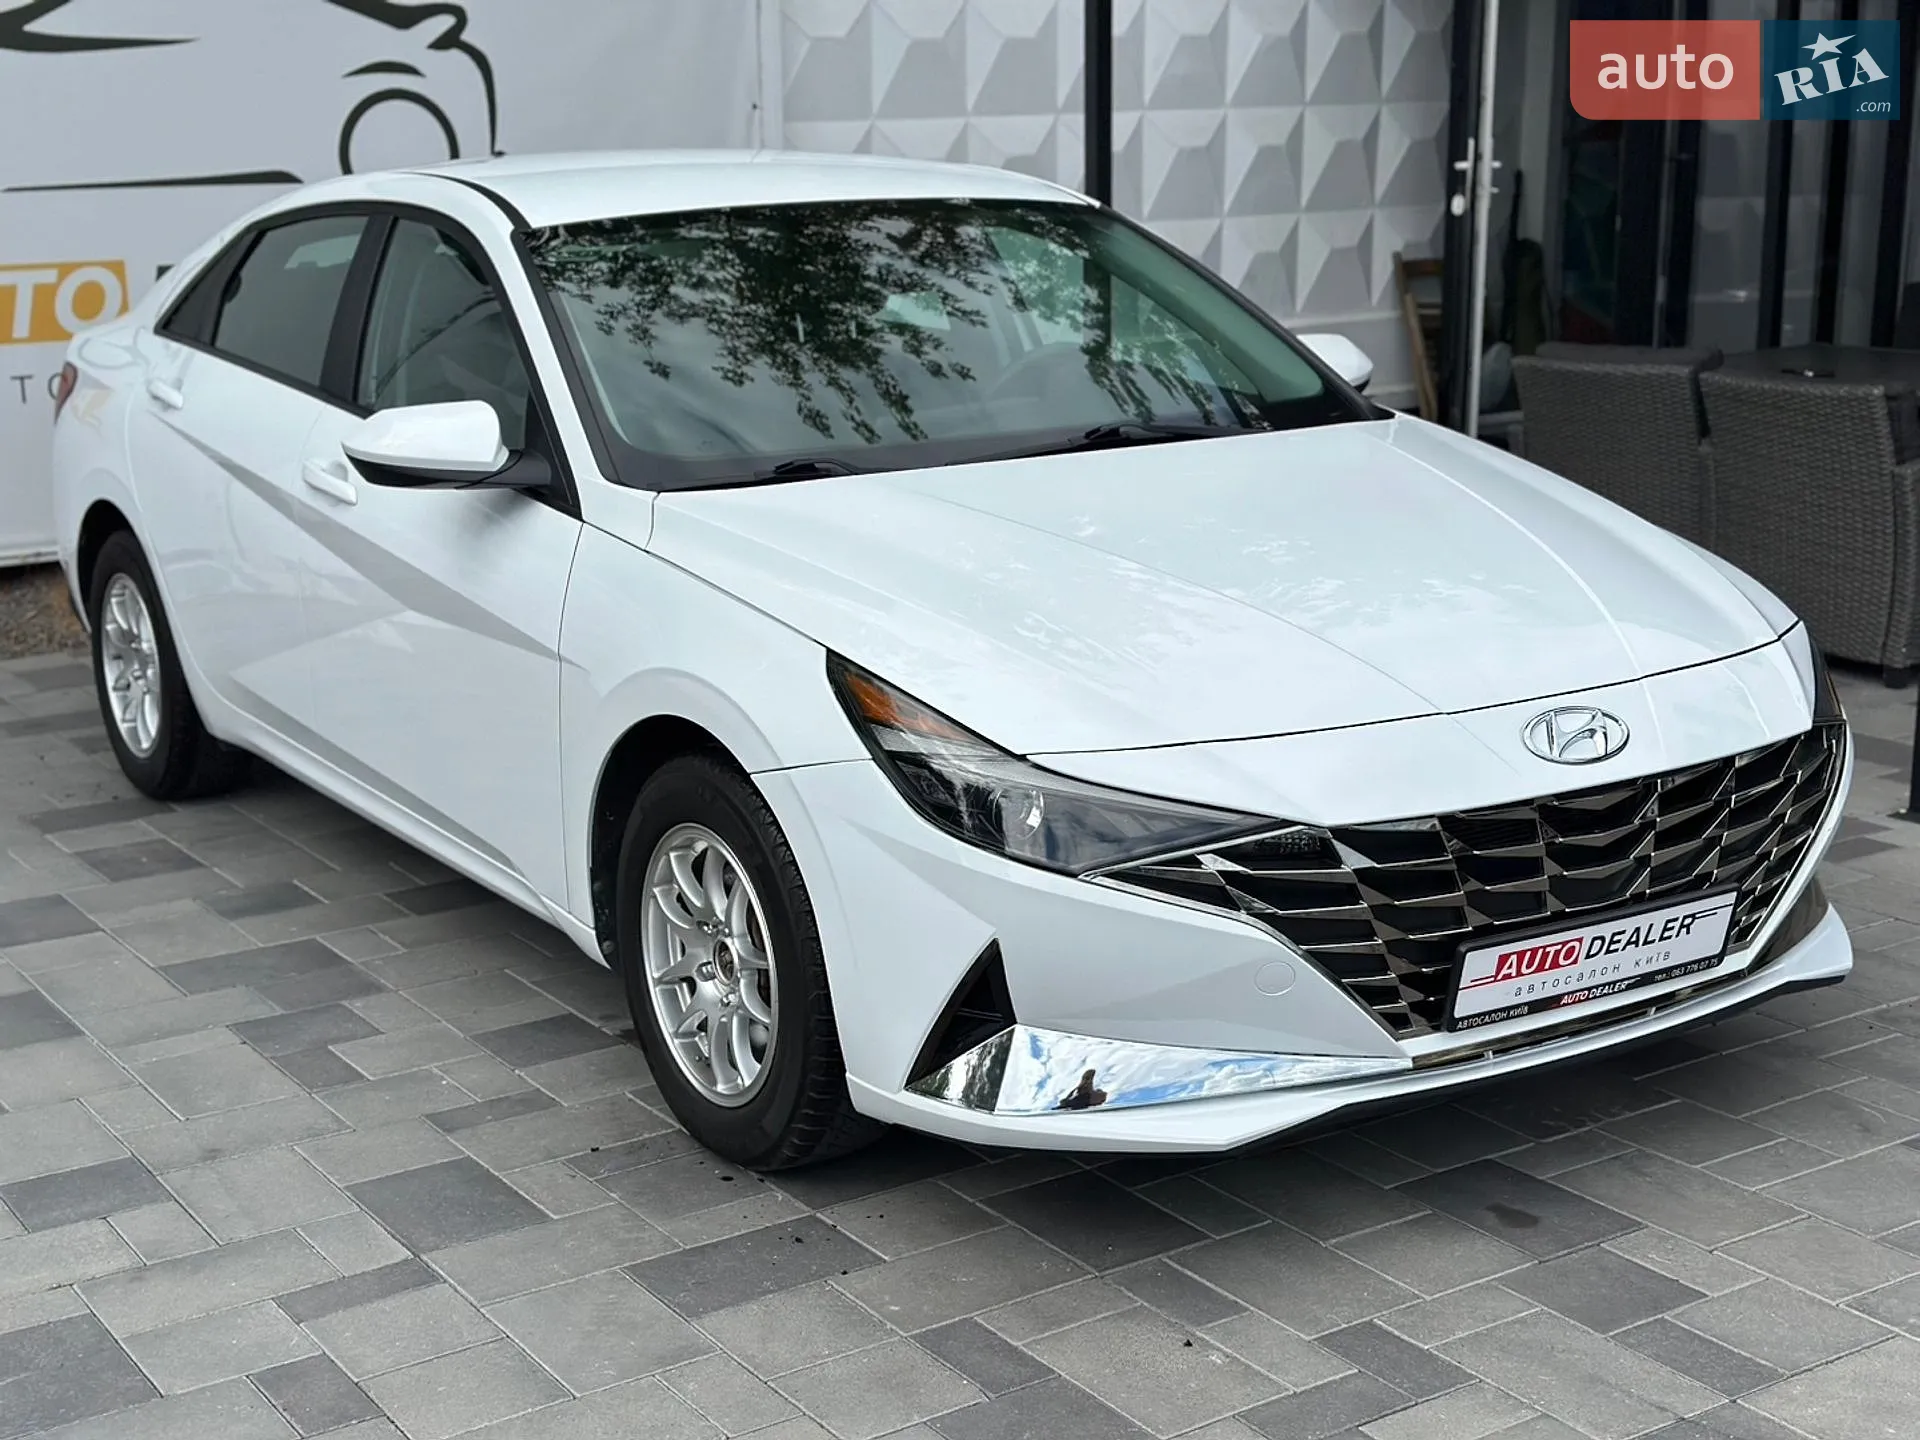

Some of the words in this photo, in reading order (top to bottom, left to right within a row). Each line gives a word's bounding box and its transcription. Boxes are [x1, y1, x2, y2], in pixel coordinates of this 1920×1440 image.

[1497, 940, 1582, 980] AUTO
[1584, 914, 1698, 960] DEALER
[1560, 990, 1588, 1006] AUTO
[1589, 982, 1628, 999] DEALER
[1456, 1010, 1508, 1030] АВТОСАЛОН
